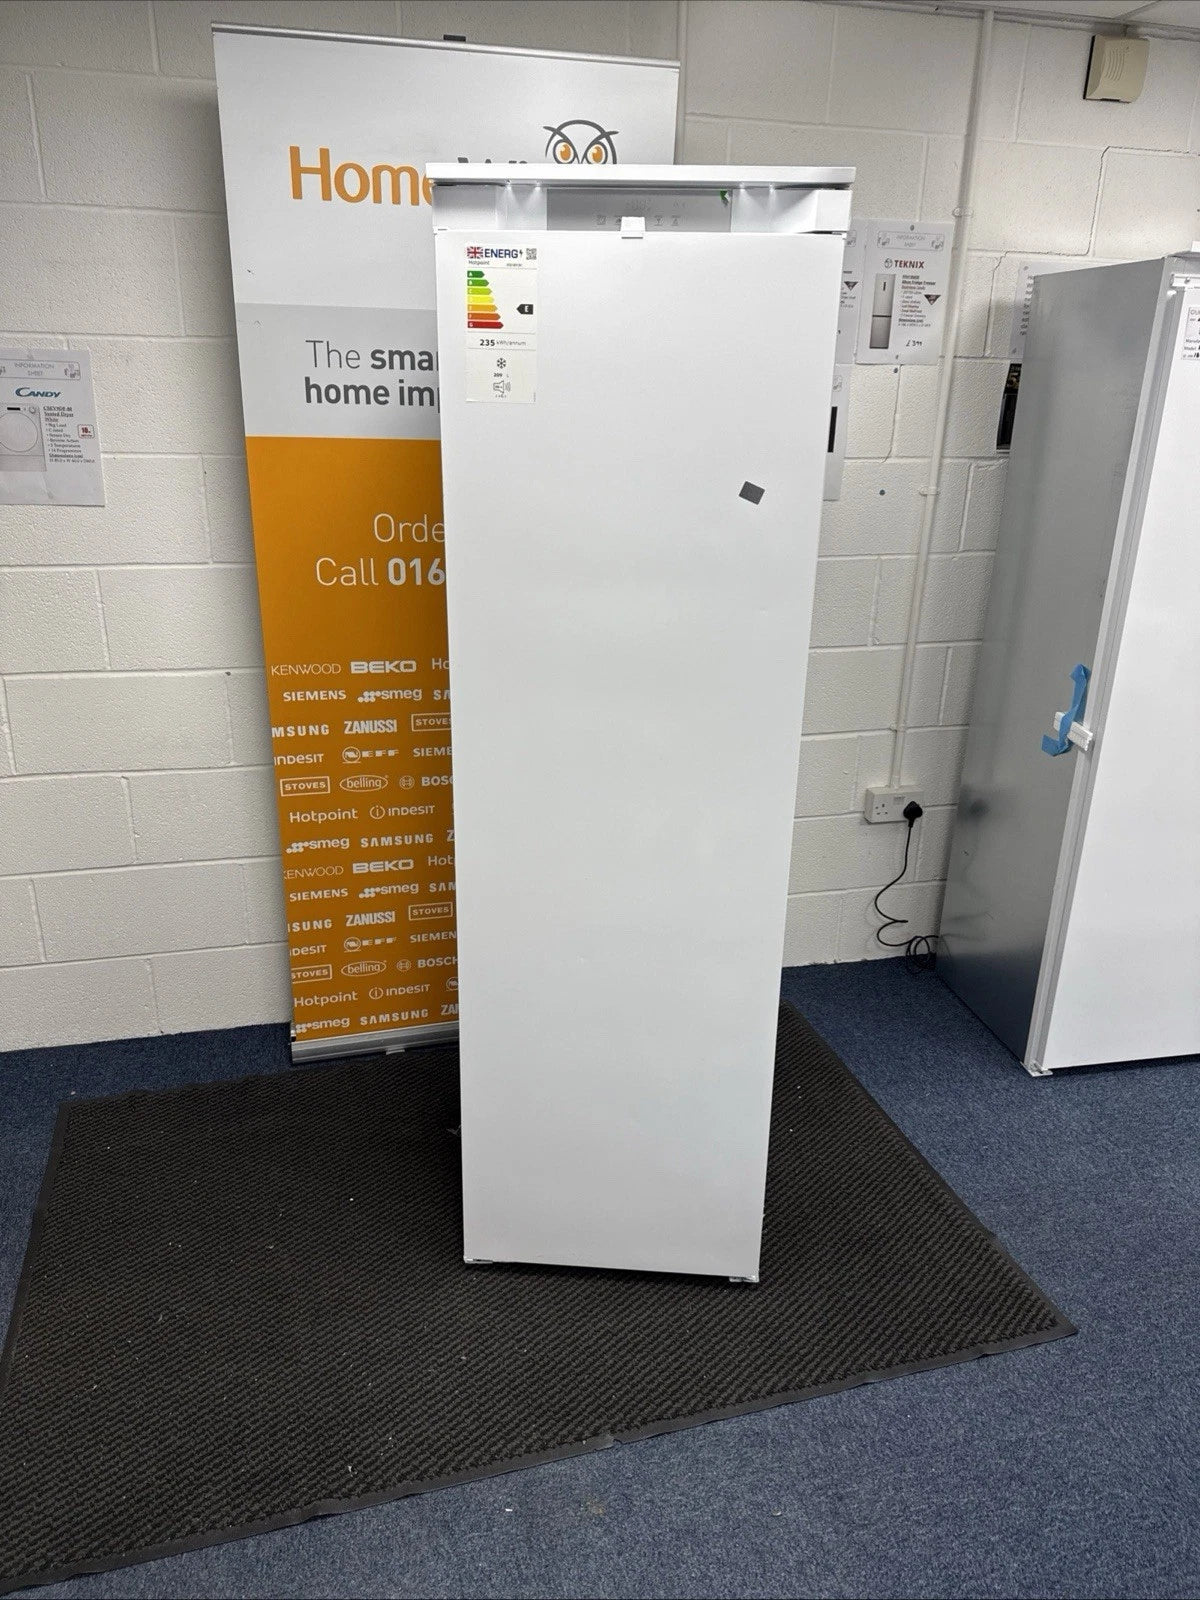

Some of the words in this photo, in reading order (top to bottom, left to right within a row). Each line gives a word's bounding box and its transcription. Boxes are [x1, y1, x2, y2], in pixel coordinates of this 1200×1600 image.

[484, 248, 519, 259] ENERG
[894, 260, 925, 269] TEKNIX
[479, 338, 496, 347] 235
[305, 340, 361, 369] The
[370, 349, 440, 371] sma
[15, 387, 62, 398] CANDY
[304, 376, 390, 405] home
[399, 379, 441, 413] im
[373, 513, 446, 543] Orde
[316, 557, 379, 586] Call
[388, 558, 446, 586] 016
[271, 663, 342, 676] KENWOOD
[350, 660, 418, 674] BEKO
[283, 690, 347, 702] SIEMENS
[381, 689, 422, 701] smeg
[272, 724, 330, 738] MSUNG
[344, 719, 398, 735] ZANUSSI
[284, 781, 326, 791] STOVES
[346, 776, 382, 789] belling
[289, 808, 359, 824] Hotpoint
[309, 838, 350, 850] smeg
[360, 834, 434, 848] SAMSUNG
[352, 859, 414, 874] BEKO
[289, 888, 348, 902] SIEMENS
[380, 883, 419, 894] smeg
[287, 919, 332, 933] SUNG
[345, 911, 396, 927] ZANUSSI
[412, 907, 450, 916] STOVES
[410, 931, 457, 944] SIEMEN
[291, 969, 329, 980] STOVES
[347, 961, 381, 974] belling
[294, 991, 359, 1007] Hotpoint
[312, 1017, 350, 1029] smeg
[360, 1009, 429, 1026] SAMSUNG
